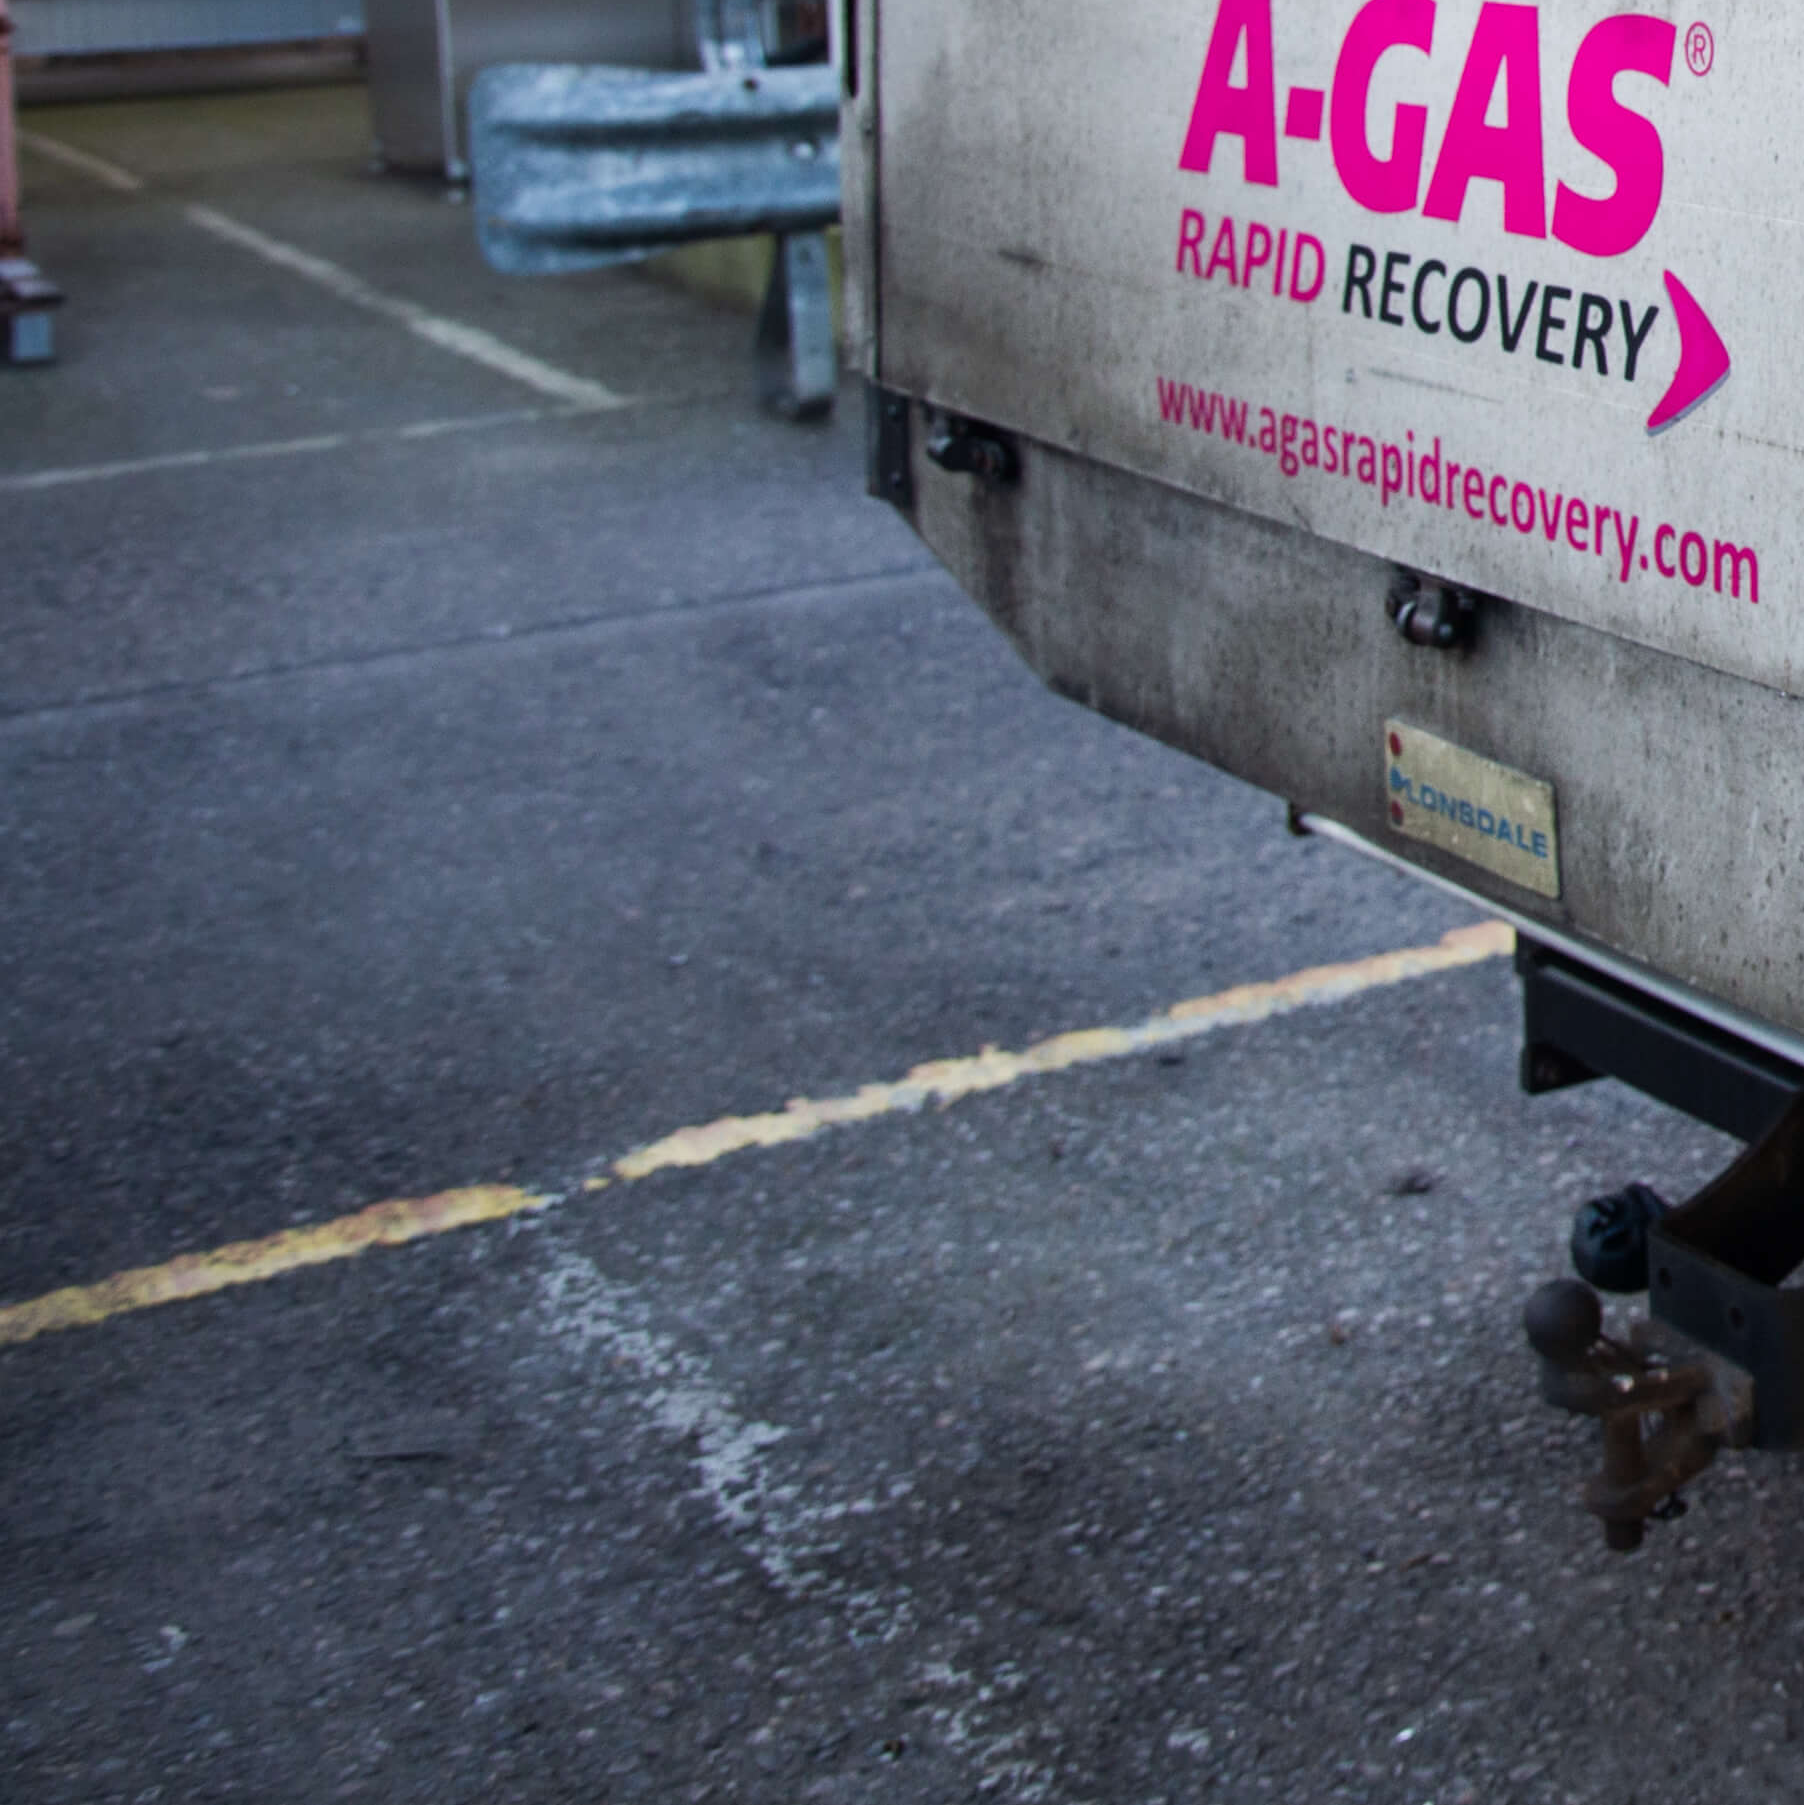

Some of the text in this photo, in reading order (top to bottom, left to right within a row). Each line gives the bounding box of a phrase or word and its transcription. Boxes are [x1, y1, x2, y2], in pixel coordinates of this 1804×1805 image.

[1175, 206, 1660, 383] RAPID RECOVERY
[1156, 378, 1761, 605] www.agasrapidrecovery.com
[1404, 776, 1548, 859] LONSDALE
